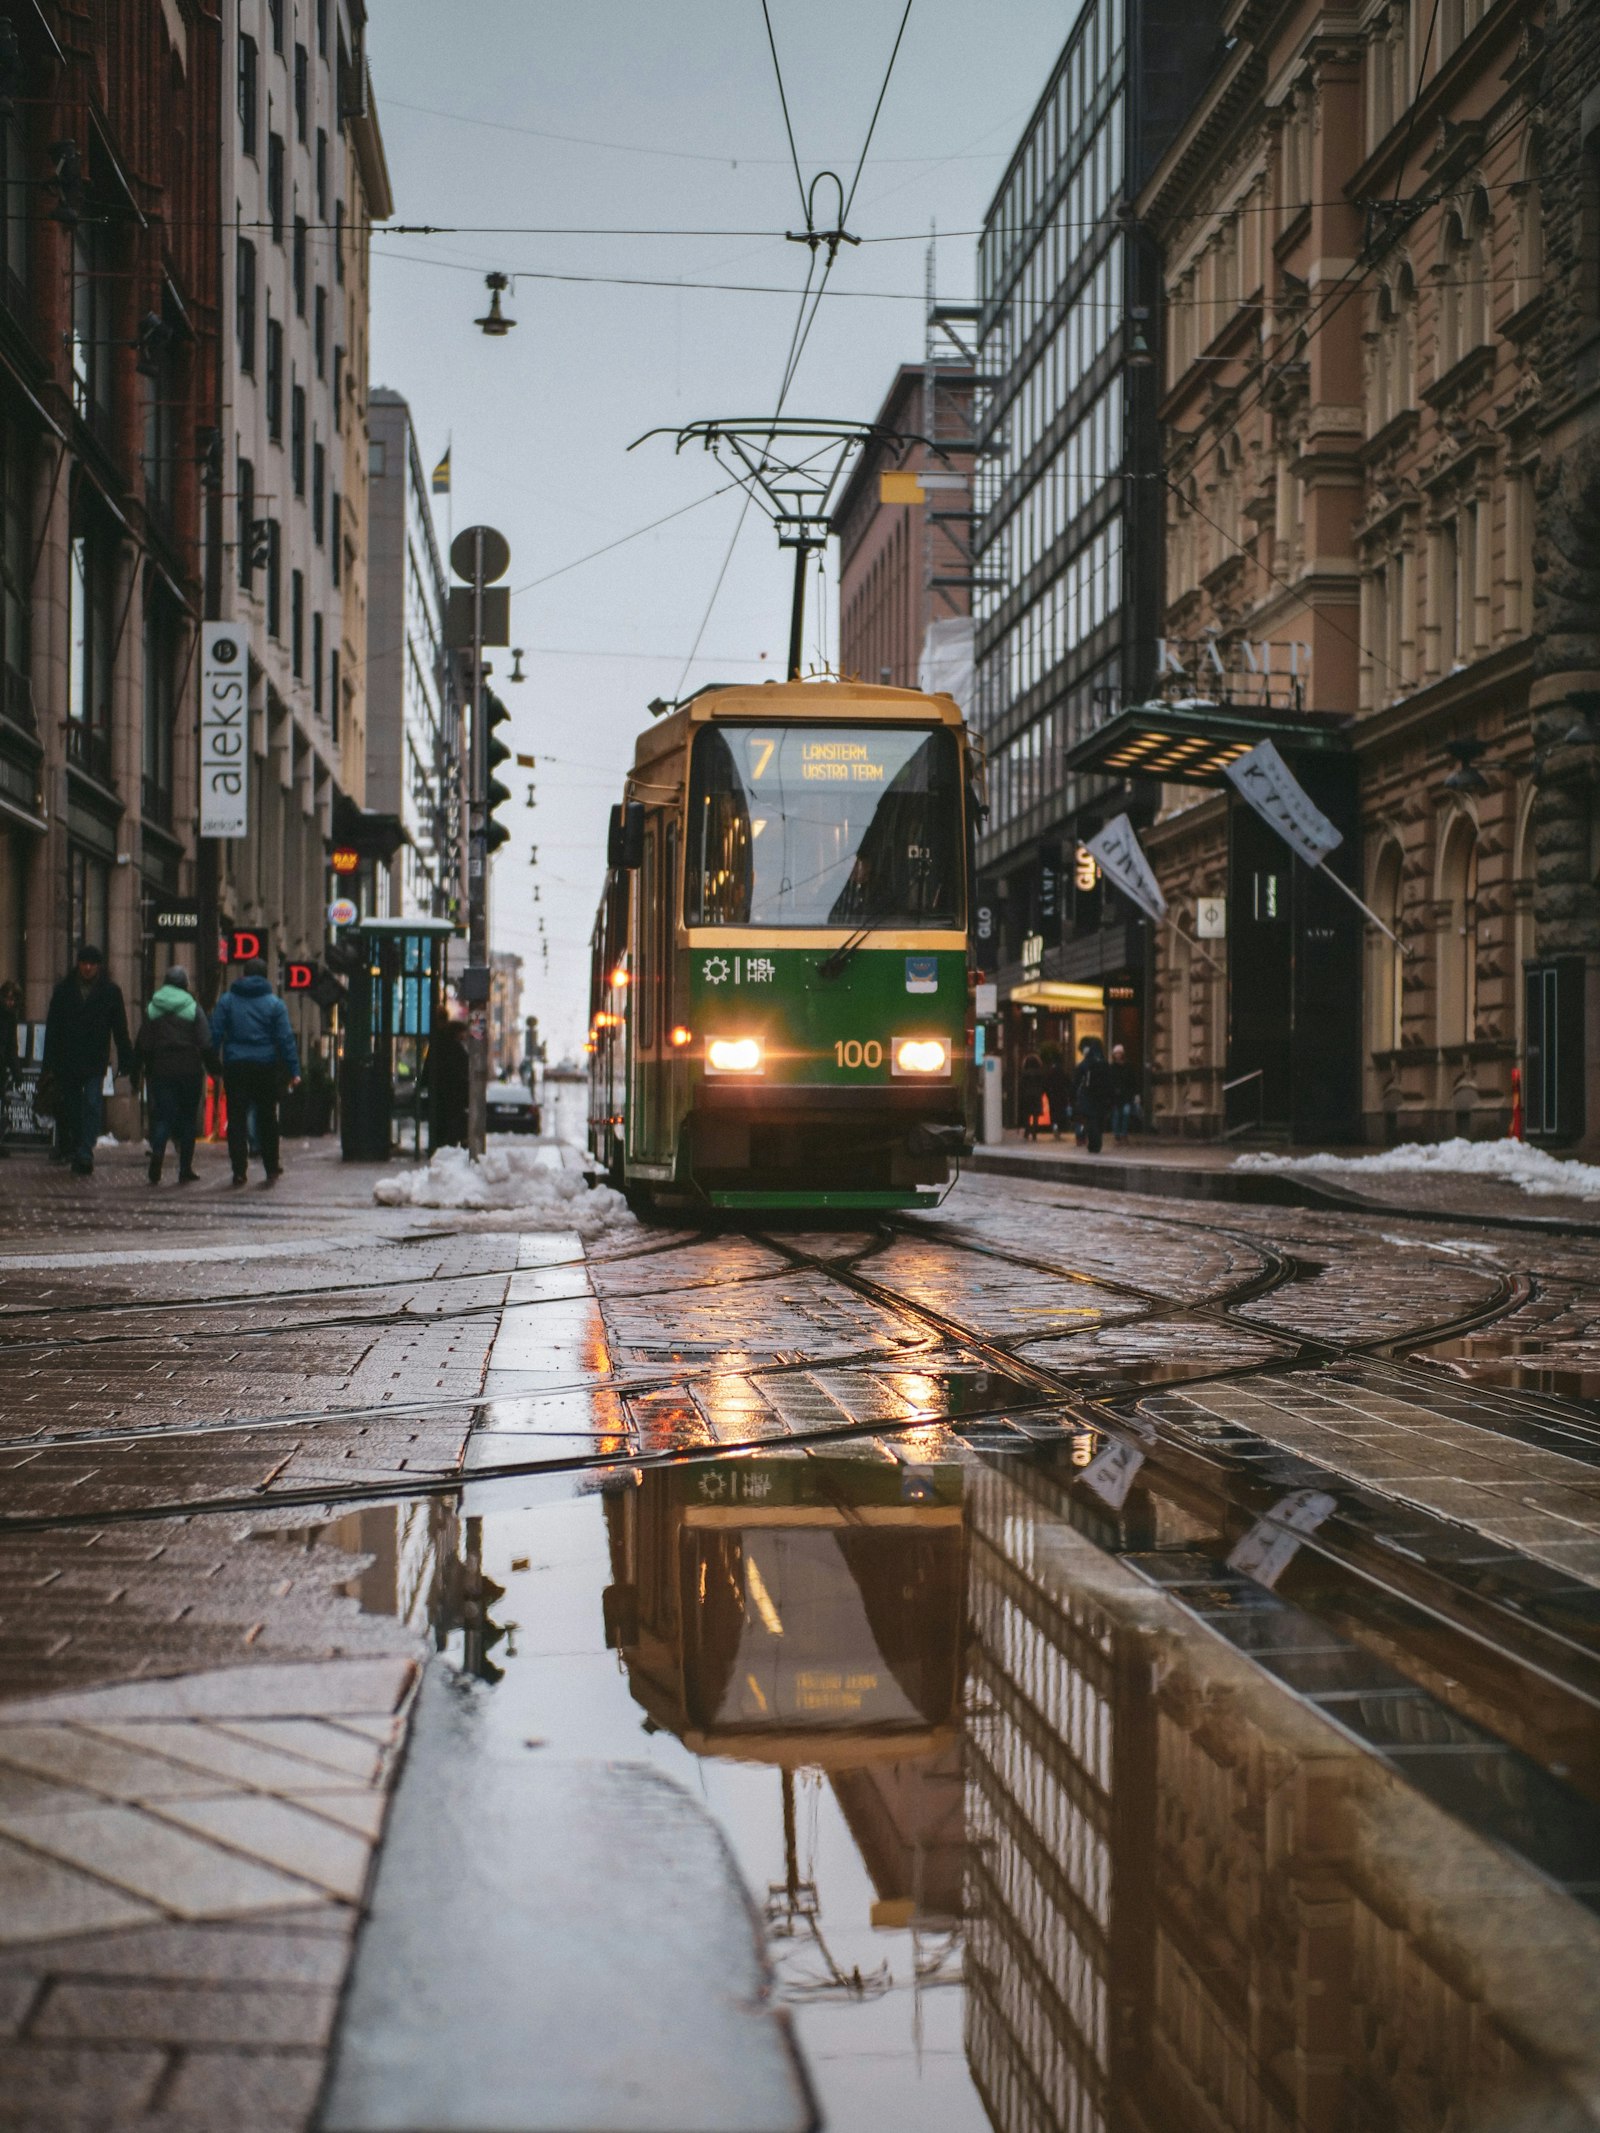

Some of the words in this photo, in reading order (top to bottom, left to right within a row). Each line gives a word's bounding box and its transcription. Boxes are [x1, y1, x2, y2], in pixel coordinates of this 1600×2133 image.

[203, 670, 242, 796] aleksi
[751, 739, 775, 780] 7
[158, 913, 198, 927] GUESS
[978, 906, 992, 939] GLO
[233, 932, 260, 960] D
[289, 965, 312, 988] D
[747, 958, 775, 971] HSL
[747, 971, 775, 983] HRT
[834, 1040, 883, 1068] 100
